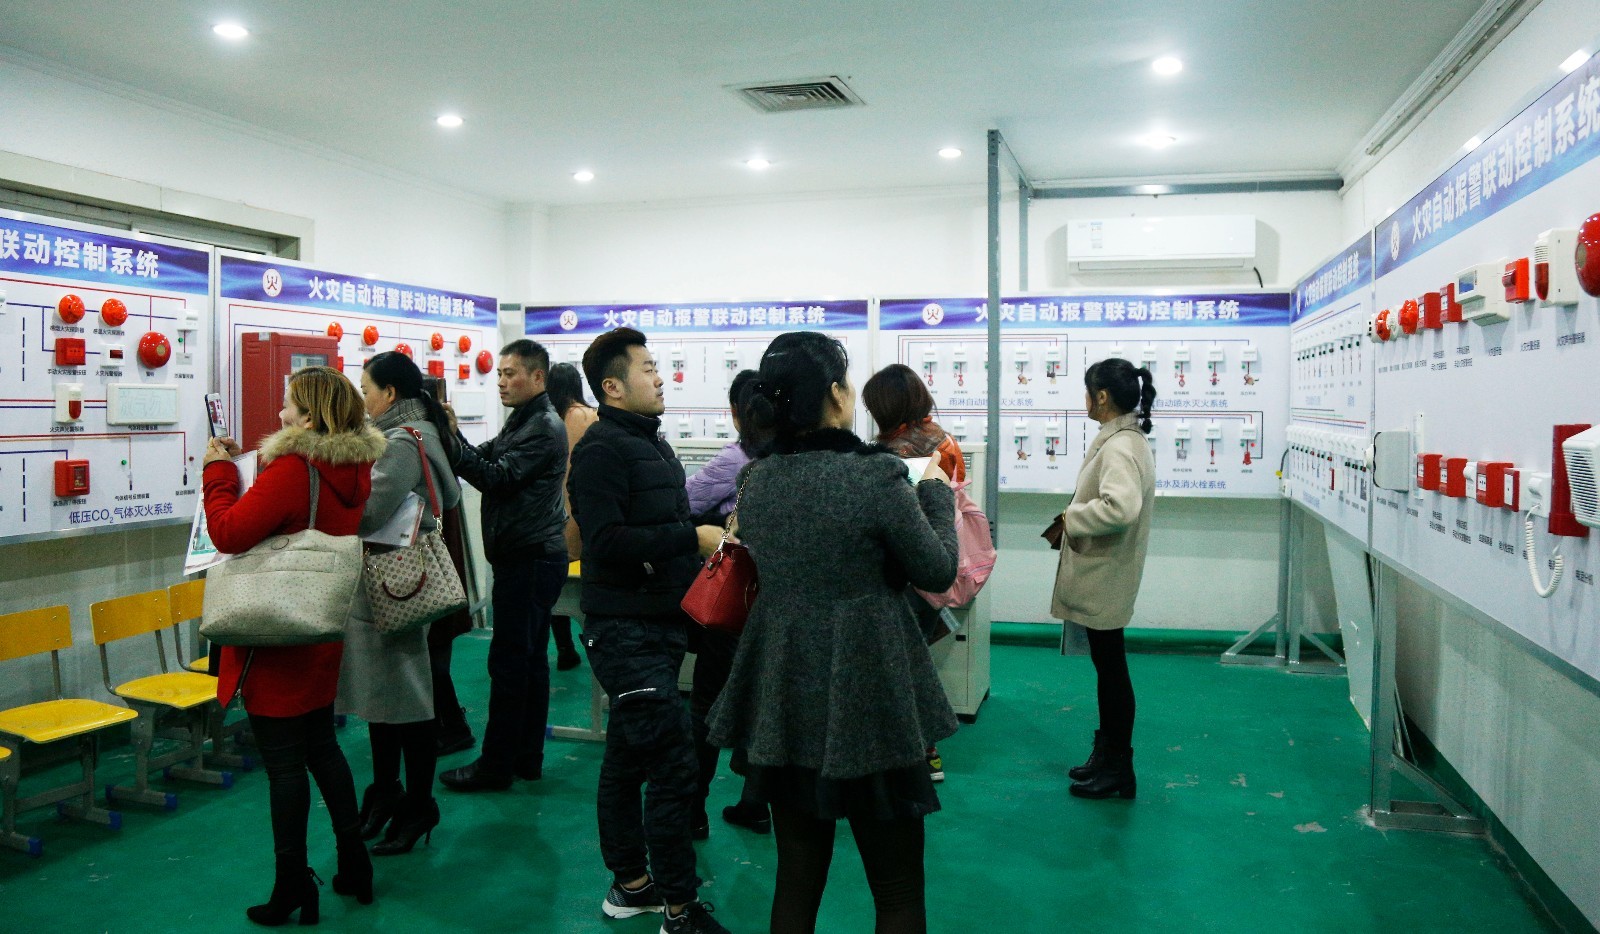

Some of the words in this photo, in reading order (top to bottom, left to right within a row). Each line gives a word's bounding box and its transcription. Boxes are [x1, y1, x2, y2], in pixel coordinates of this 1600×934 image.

[1412, 75, 1600, 245] 火灾自动报警联动控制系统
[0, 228, 159, 279] 联动控制系统
[308, 275, 475, 319] 火灾自动报警联动控制系统
[975, 299, 1240, 322] 火灾自动报警联动控制系统
[603, 305, 826, 328] 火灾自动报警联动控制系统
[949, 397, 1034, 407] 雨淋自动灭火系统
